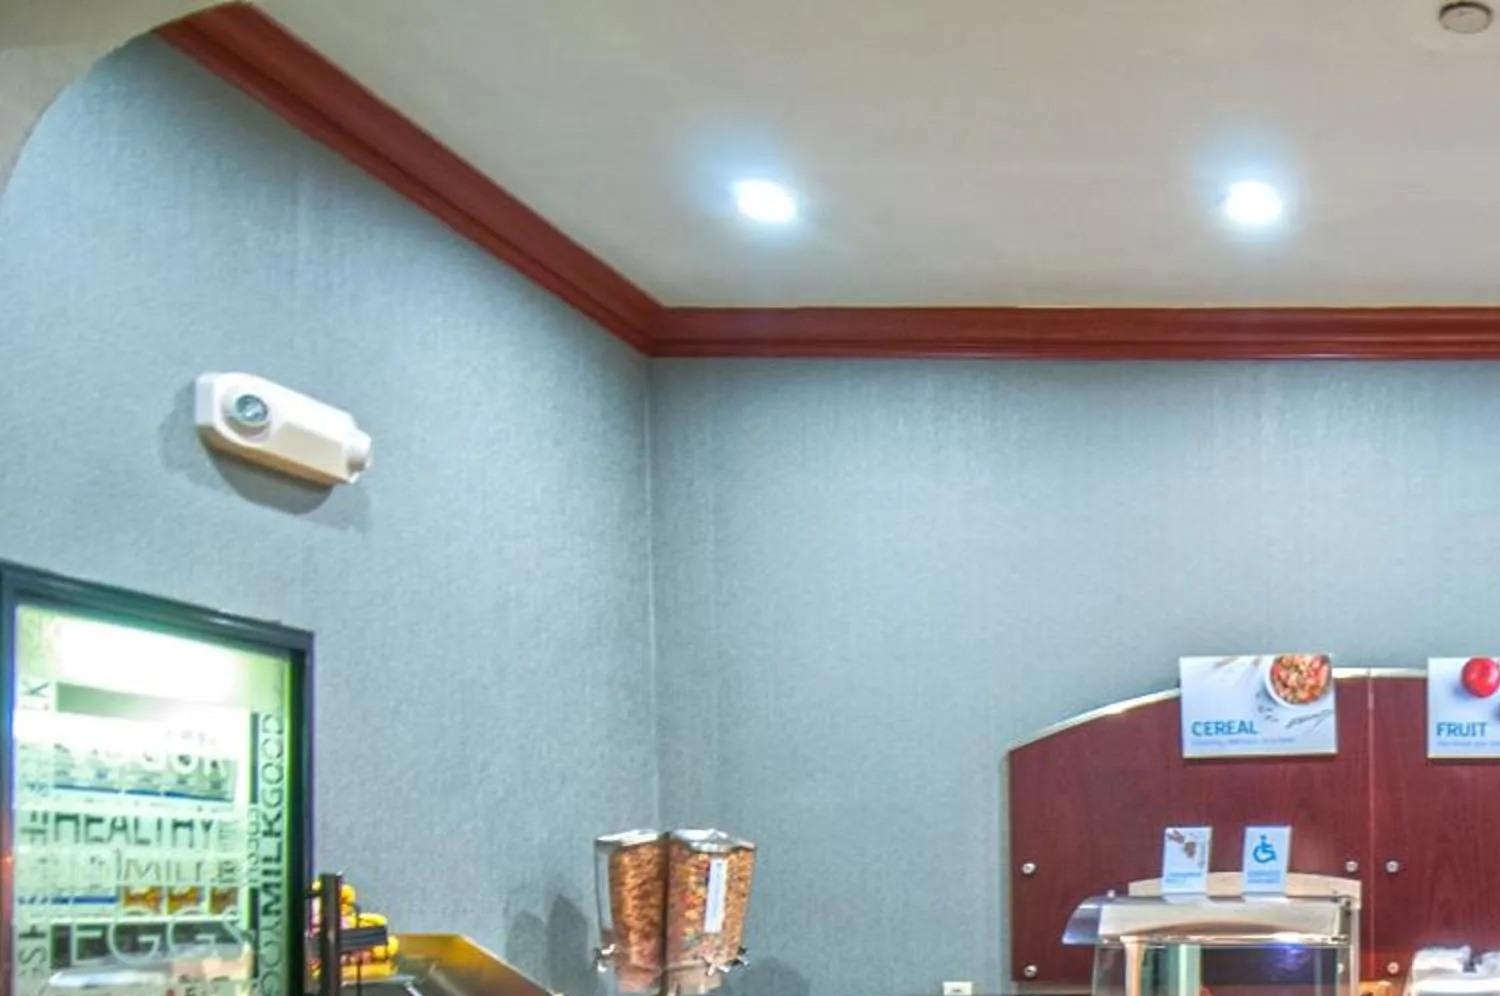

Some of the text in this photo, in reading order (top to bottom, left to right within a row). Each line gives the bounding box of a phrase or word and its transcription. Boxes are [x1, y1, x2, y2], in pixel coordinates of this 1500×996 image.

[1191, 720, 1259, 737] CEREAL
[1436, 722, 1488, 737] FRUIT
[54, 812, 213, 849] HEALTHY
[261, 807, 282, 917] MILK
